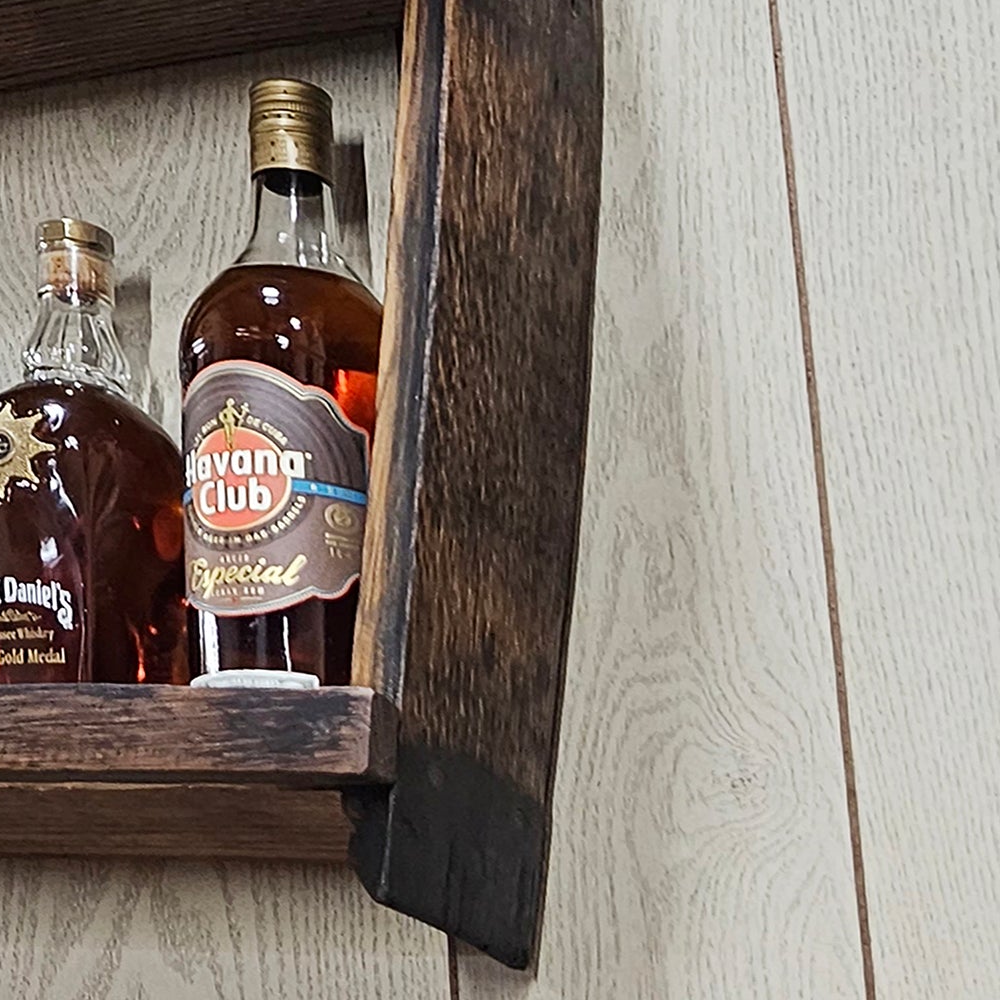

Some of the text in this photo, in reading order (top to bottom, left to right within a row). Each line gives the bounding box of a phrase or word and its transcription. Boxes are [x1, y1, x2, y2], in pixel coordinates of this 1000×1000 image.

[184, 448, 306, 488] Havana
[199, 475, 272, 516] Club
[190, 553, 308, 600] Especial
[26, 646, 67, 665] Medal
